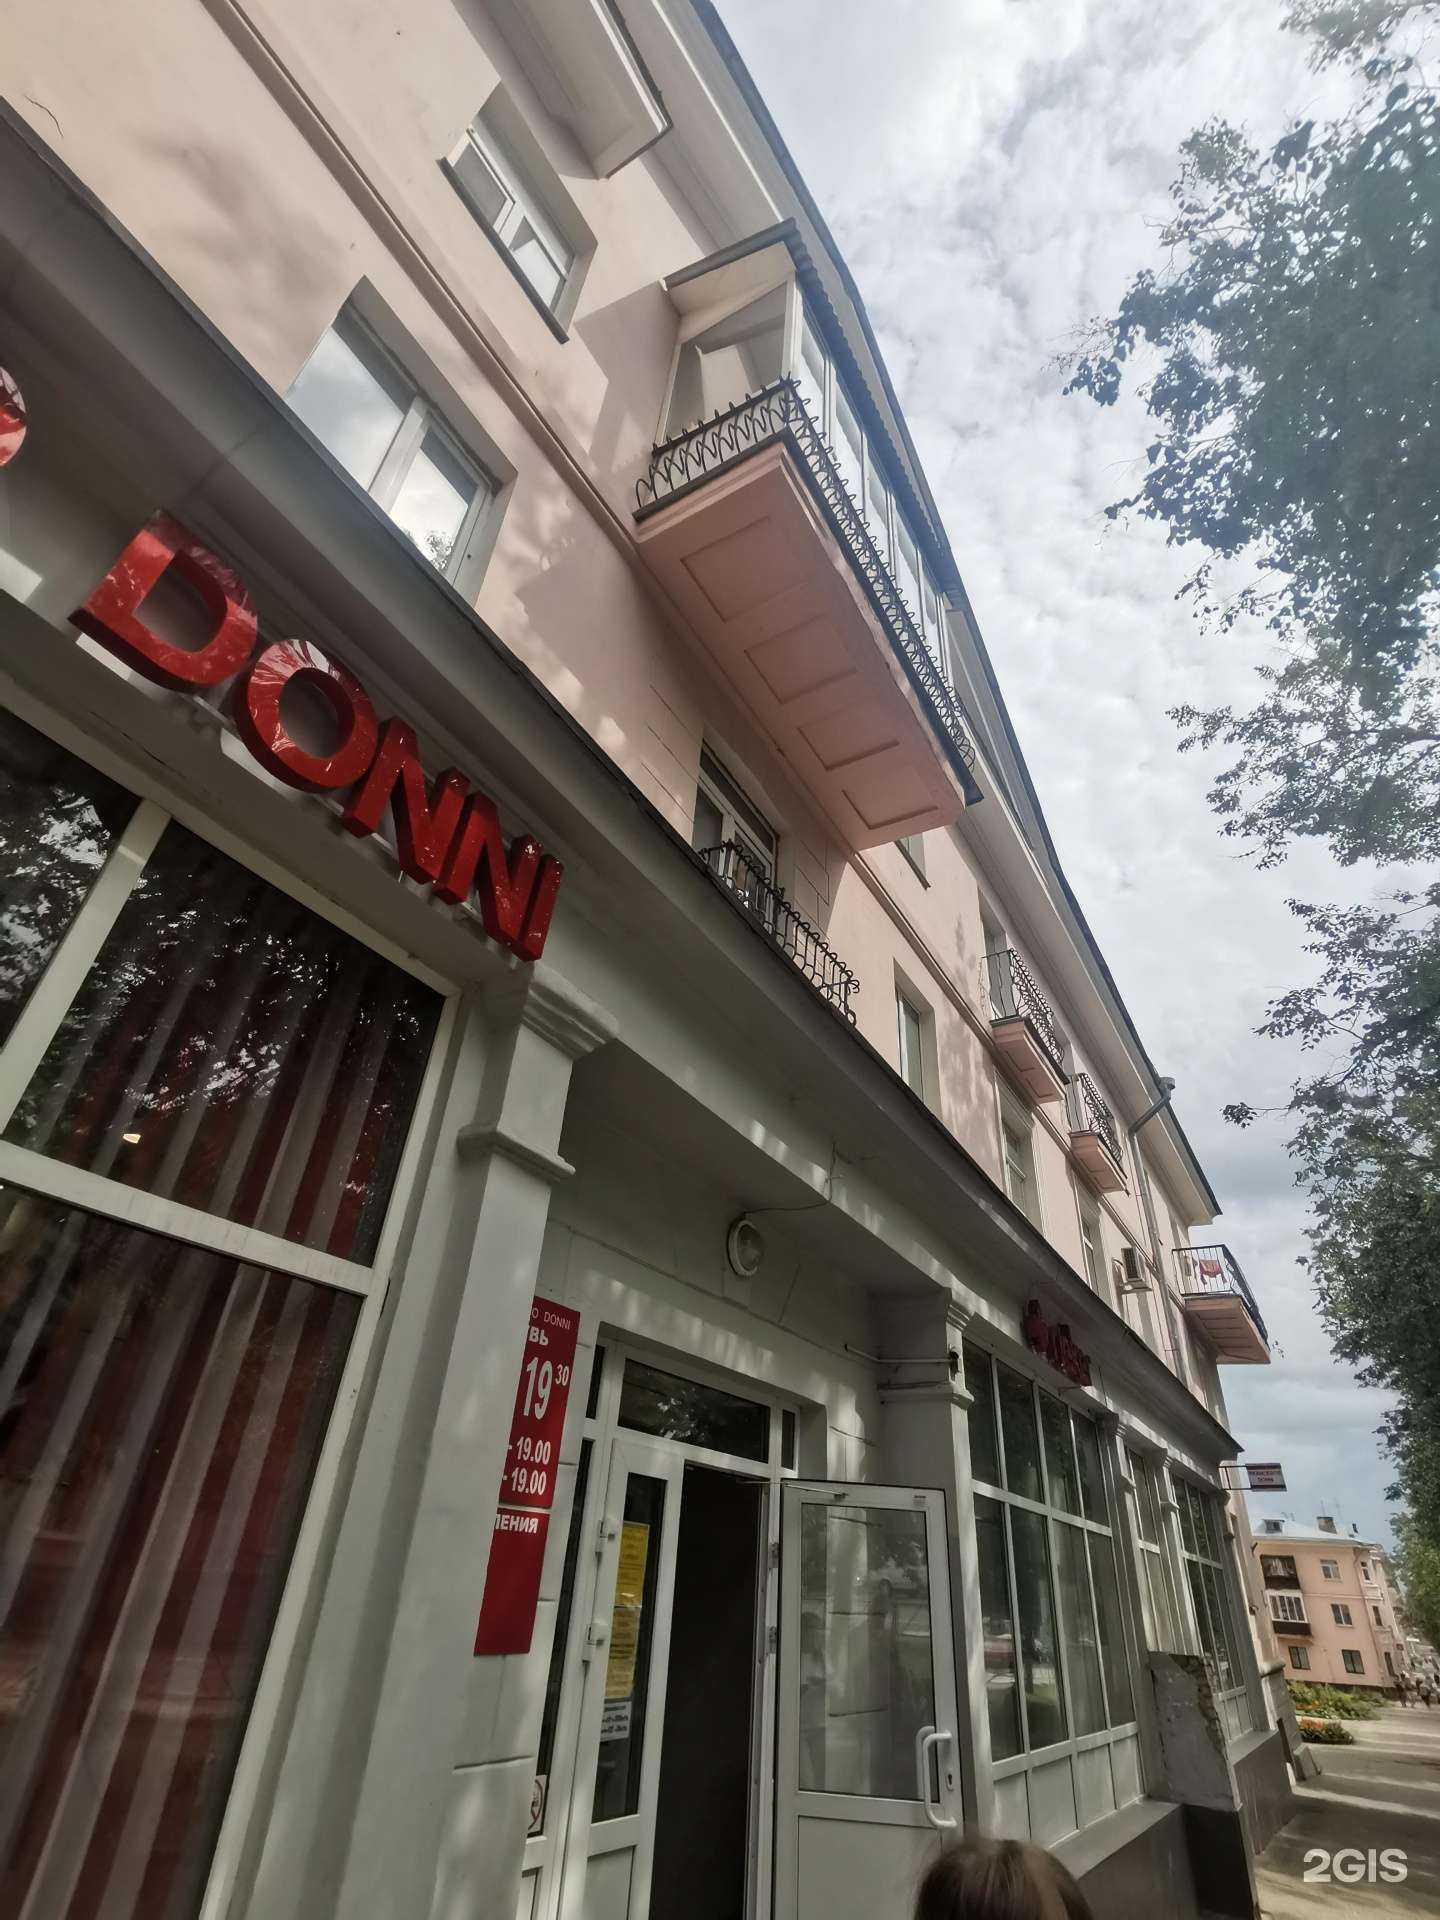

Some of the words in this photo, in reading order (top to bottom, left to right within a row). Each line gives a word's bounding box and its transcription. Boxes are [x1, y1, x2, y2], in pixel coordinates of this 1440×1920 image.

[69, 510, 564, 962] DONNI
[543, 1311, 571, 1330] DONNI
[523, 1356, 553, 1420] 19
[555, 1363, 570, 1387] 30
[517, 1436, 551, 1465] 19.00
[511, 1467, 547, 1496] 19.00
